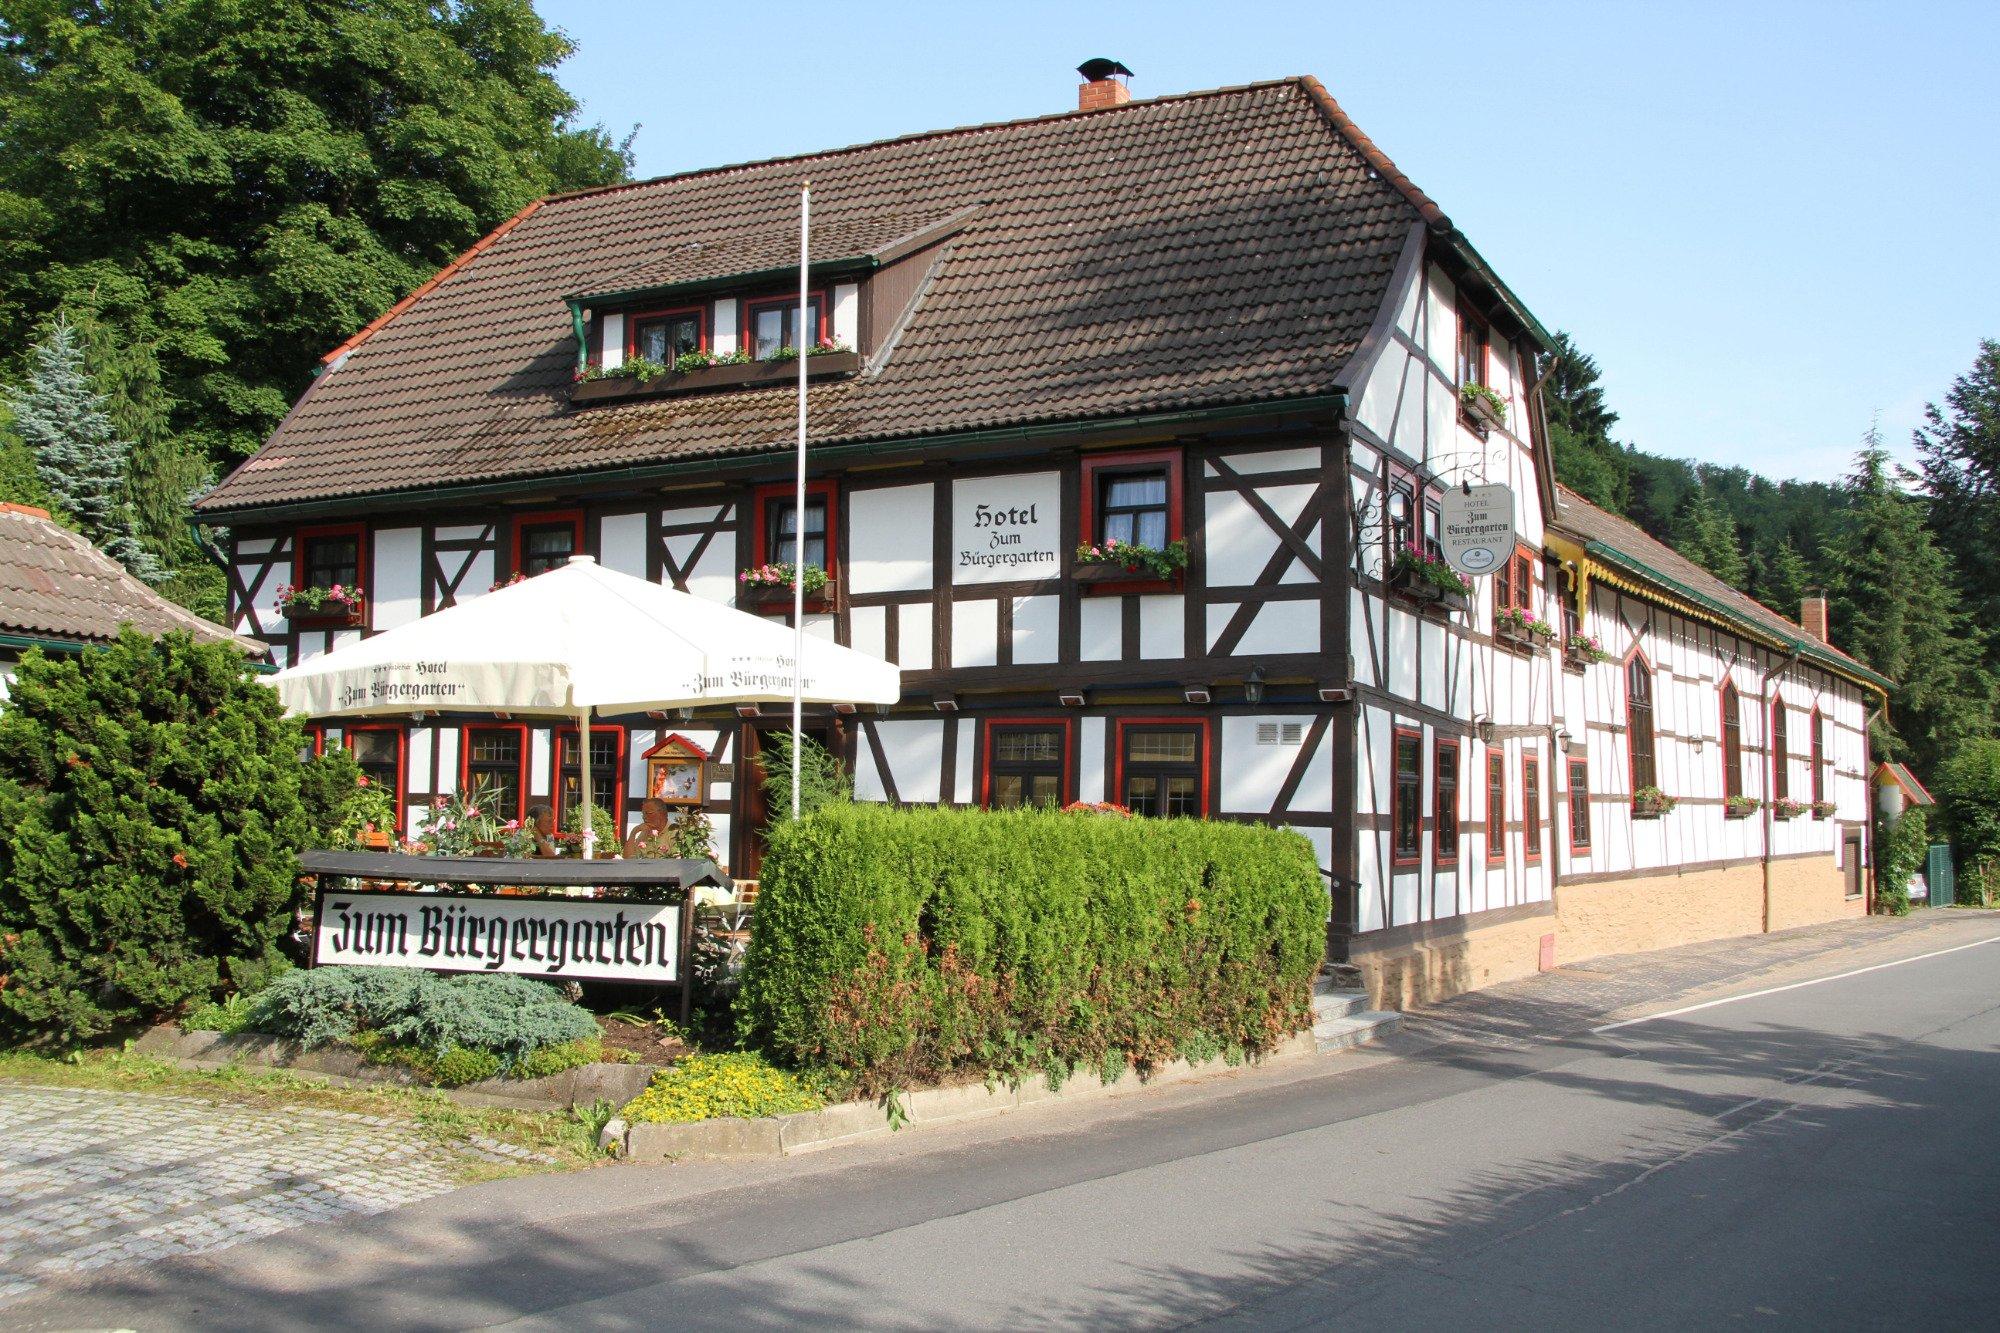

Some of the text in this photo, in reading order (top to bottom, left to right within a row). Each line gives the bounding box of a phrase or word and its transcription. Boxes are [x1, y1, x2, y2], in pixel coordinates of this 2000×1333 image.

[1464, 500, 1490, 508] HOTEL
[973, 502, 1038, 528] Hotel
[1467, 511, 1488, 524] Zum
[1447, 523, 1508, 536] Bürgergarten
[989, 531, 1021, 549] Zum
[1452, 536, 1503, 546] RESTAURANT
[959, 549, 1054, 568] Bürgergarten
[416, 660, 448, 675] Hotel
[332, 901, 670, 973] Zum Bürgergarten
